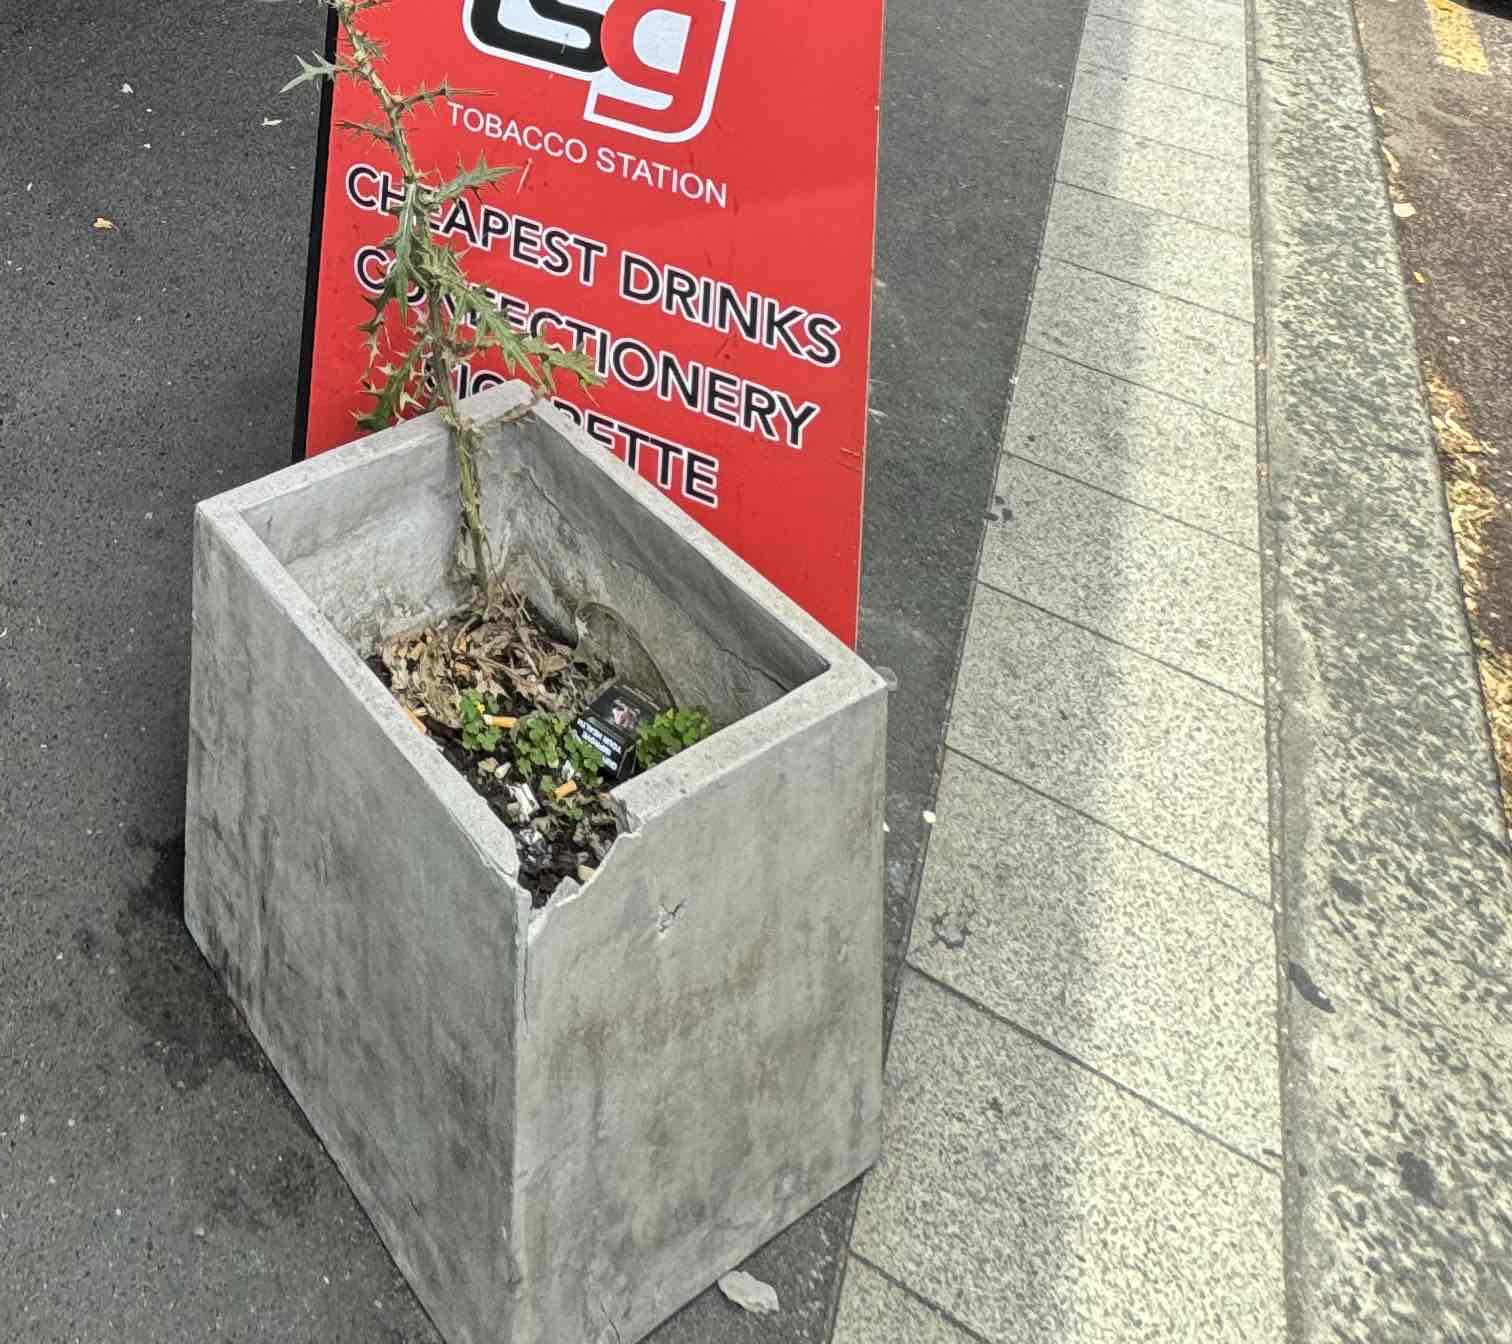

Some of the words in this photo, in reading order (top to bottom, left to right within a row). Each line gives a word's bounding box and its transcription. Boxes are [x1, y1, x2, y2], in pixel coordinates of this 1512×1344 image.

[448, 102, 587, 164] TOBACCO
[596, 147, 728, 208] STATION
[620, 250, 841, 368] DRINKS
